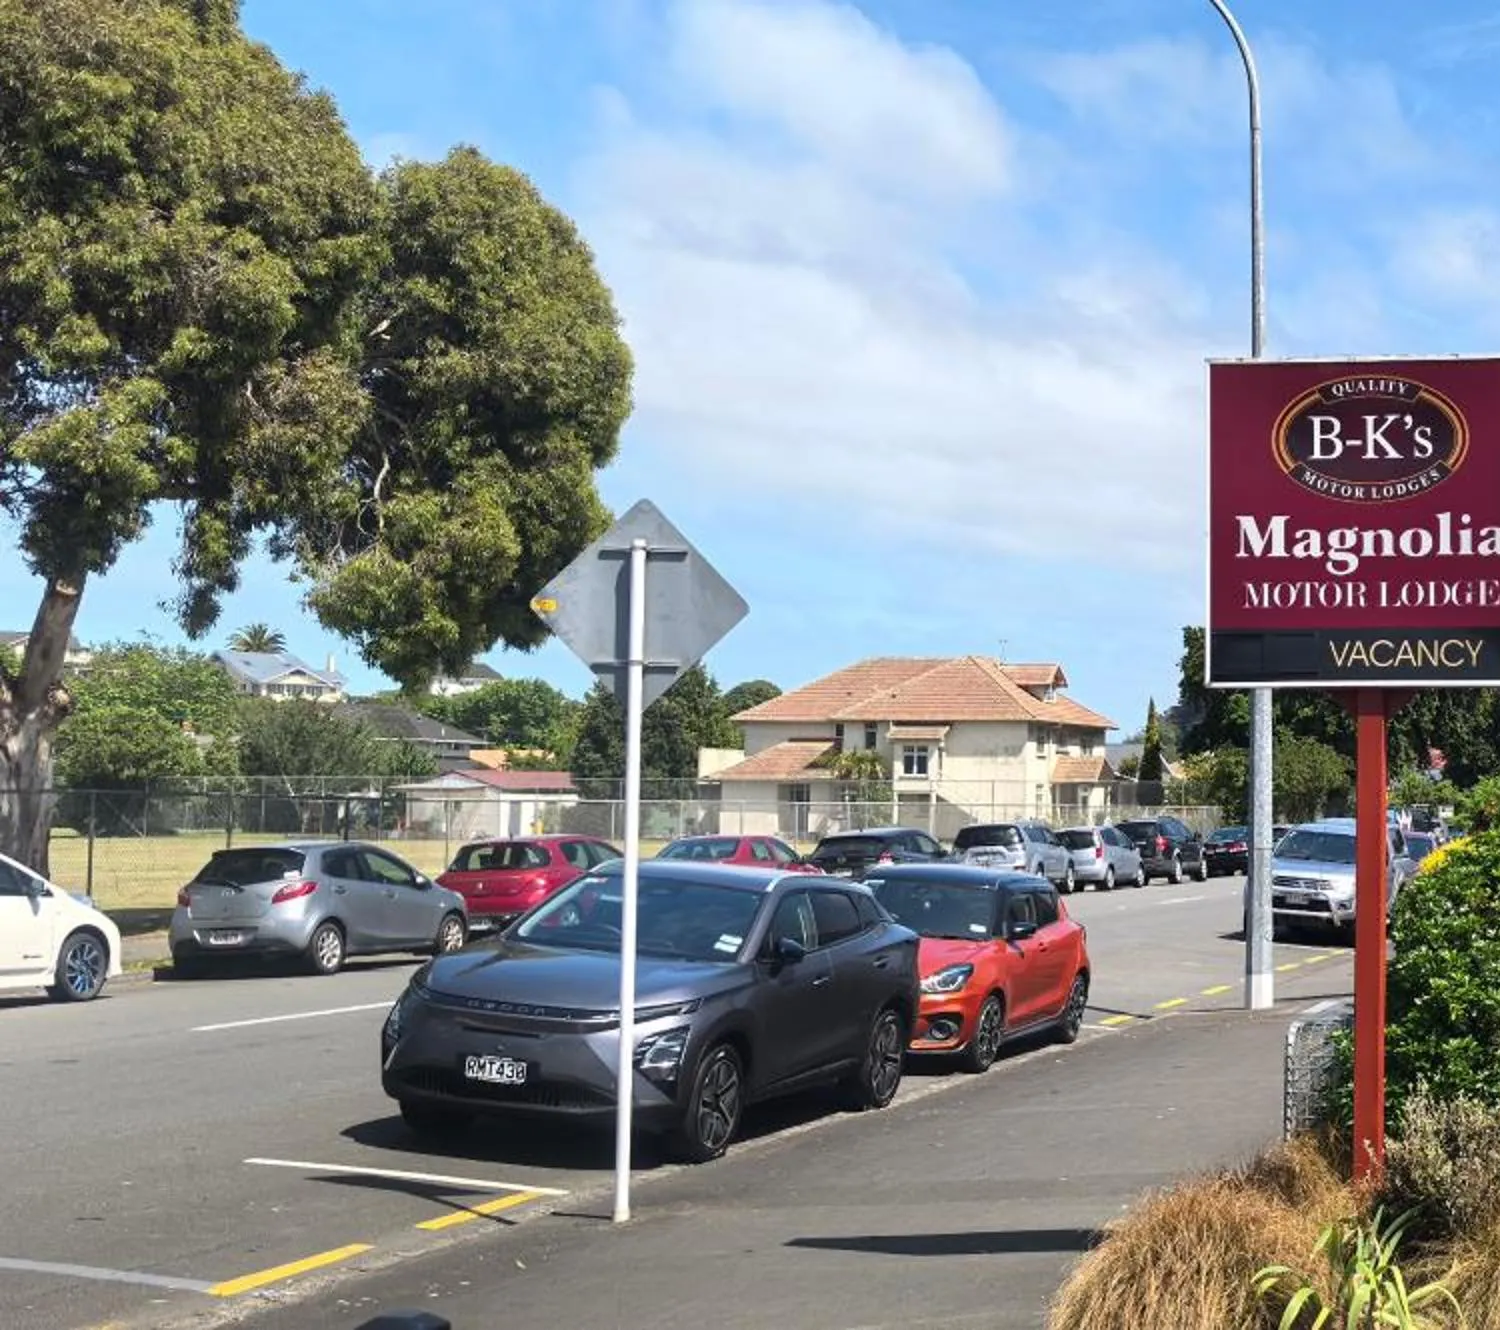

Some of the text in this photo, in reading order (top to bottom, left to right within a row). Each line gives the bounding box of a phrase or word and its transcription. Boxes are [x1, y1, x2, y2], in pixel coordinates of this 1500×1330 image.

[1332, 380, 1409, 396] QUALITY
[1308, 414, 1433, 459] B-K's
[1301, 470, 1441, 499] MOTOR LODGES
[1243, 579, 1500, 608] MOTOR LODGE
[1329, 639, 1484, 668] VACANCY
